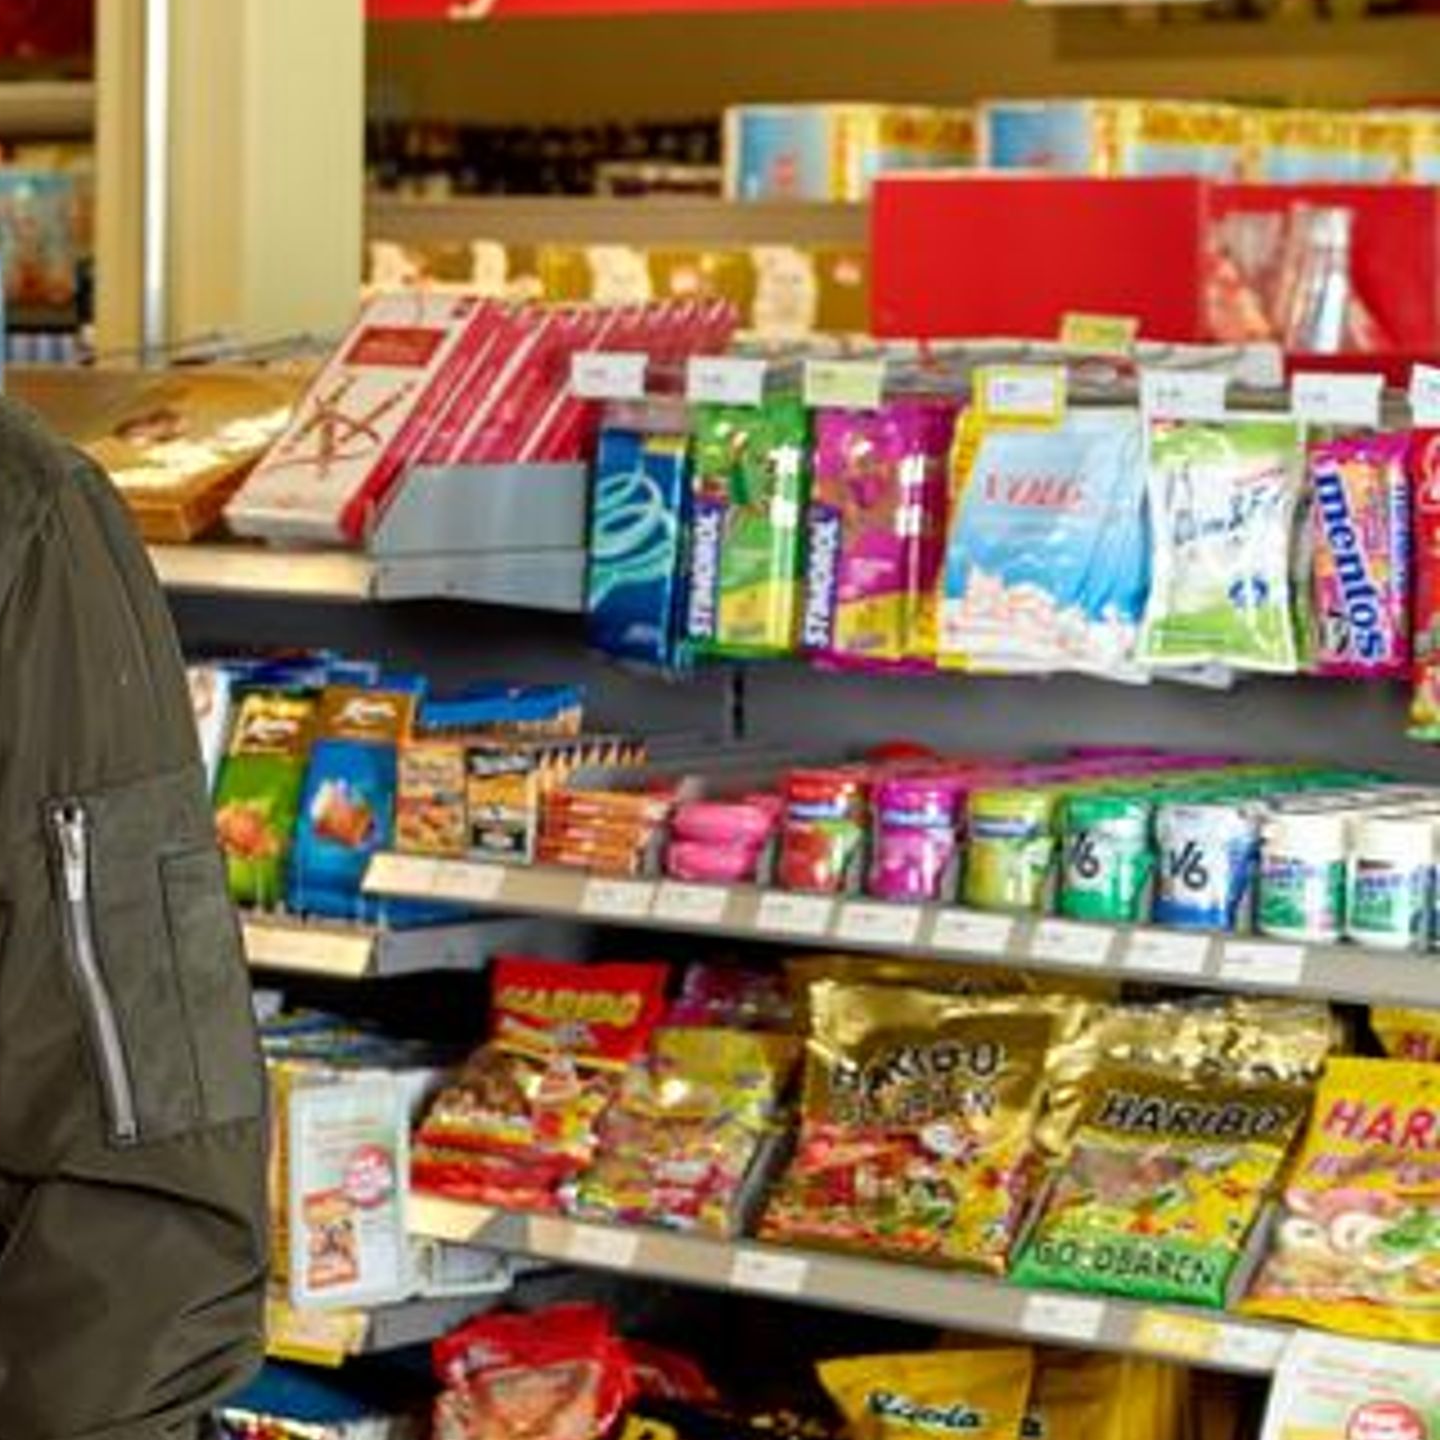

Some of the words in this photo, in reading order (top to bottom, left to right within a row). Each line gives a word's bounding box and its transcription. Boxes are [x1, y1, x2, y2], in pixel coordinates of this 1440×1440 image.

[1313, 470, 1386, 666] mentos
[1169, 841, 1210, 891] V6
[1097, 1089, 1295, 1138] HARIBO
